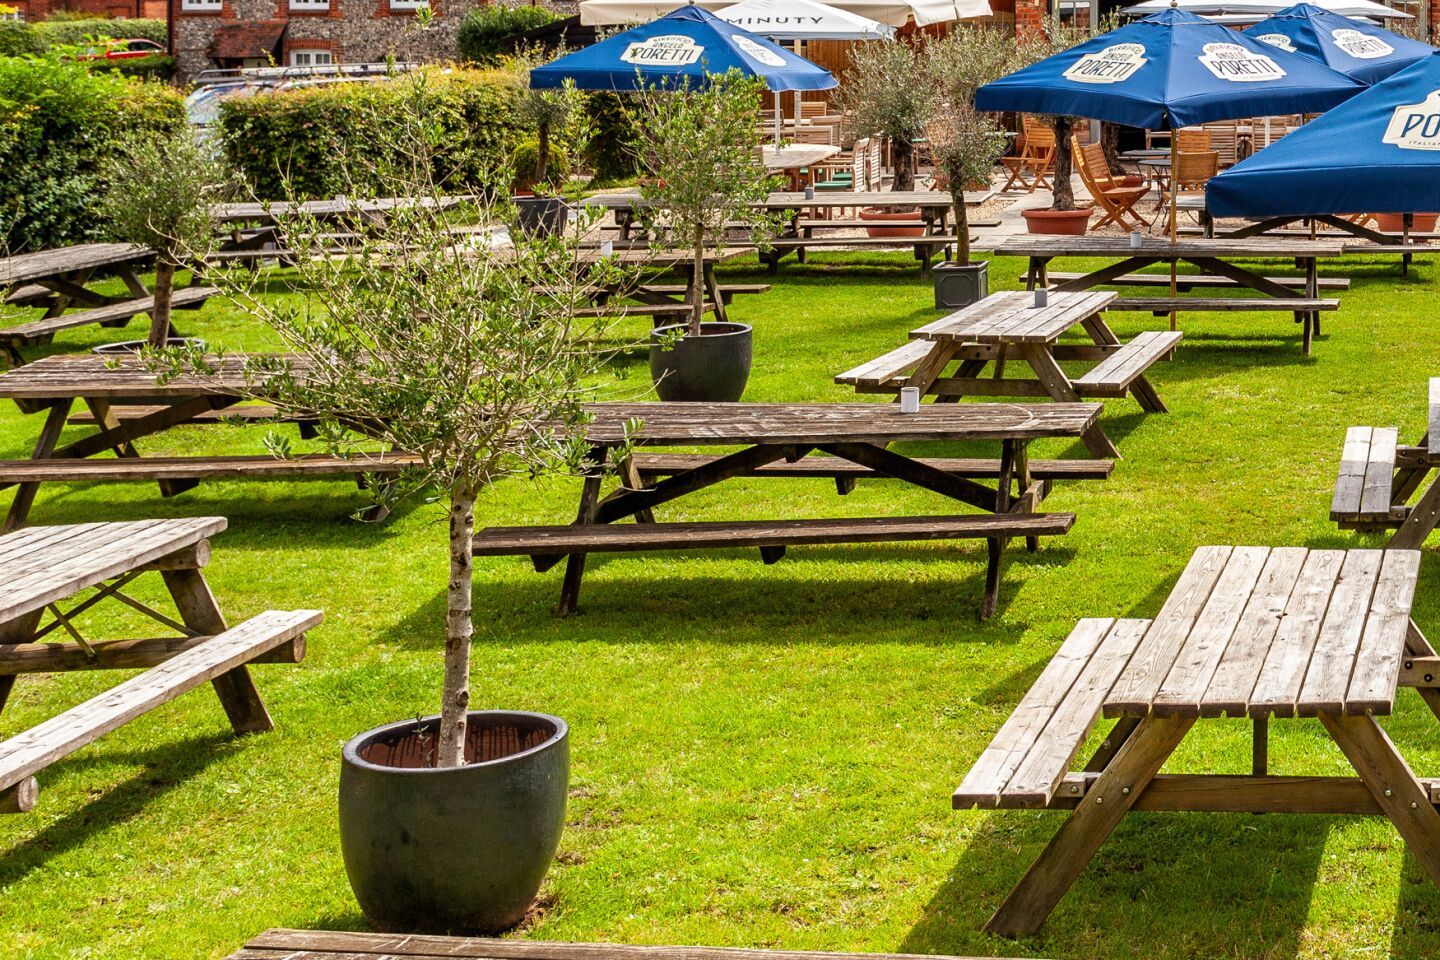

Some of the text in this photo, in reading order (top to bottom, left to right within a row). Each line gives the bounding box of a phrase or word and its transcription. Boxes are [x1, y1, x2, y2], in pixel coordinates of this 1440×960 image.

[726, 16, 824, 25] MINUTY
[1071, 59, 1136, 77] PORETTI
[1210, 59, 1278, 75] PORETTI
